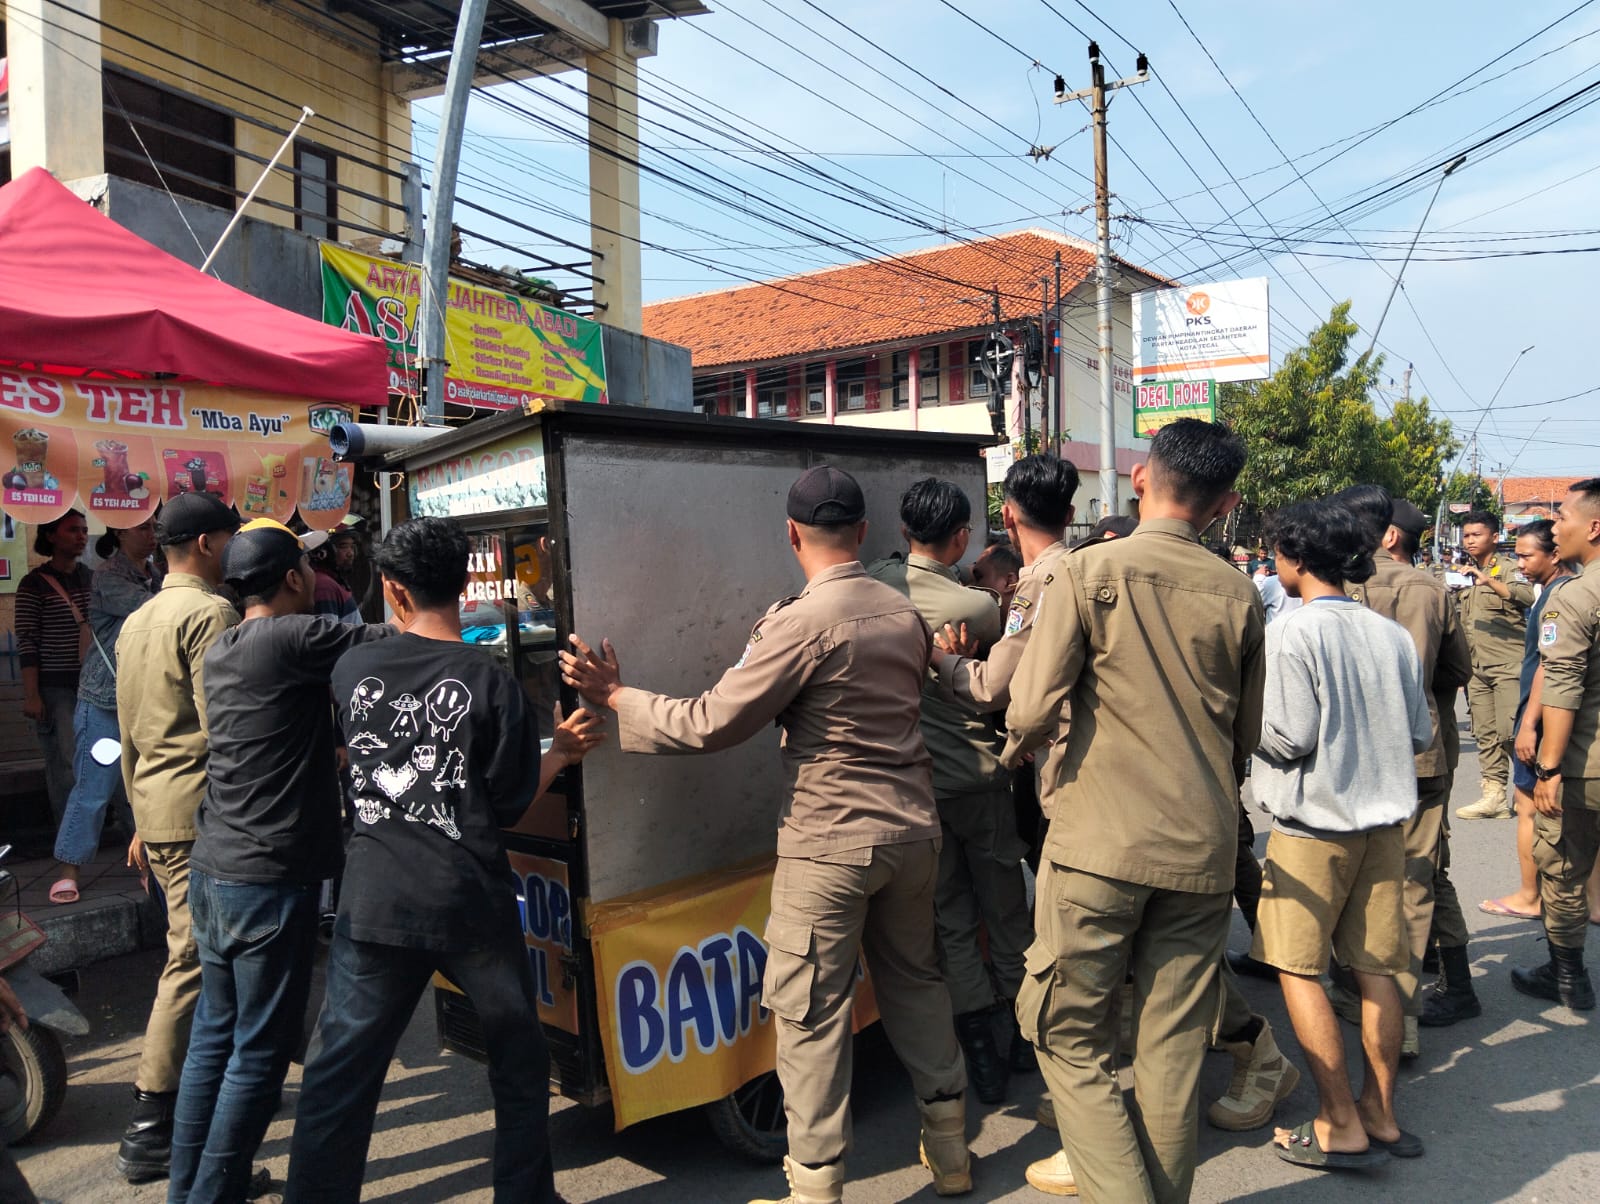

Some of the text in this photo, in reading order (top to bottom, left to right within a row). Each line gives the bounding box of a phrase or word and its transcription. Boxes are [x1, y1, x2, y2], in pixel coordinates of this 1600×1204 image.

[366, 262, 421, 297] ARTA
[533, 309, 578, 340] ABADI
[1185, 315, 1212, 327] PKS
[1142, 324, 1258, 343] DEWAN PIMPINAN TINGKAT DAERAH
[1151, 332, 1247, 348] PARTAI KEADILAN SEJAHTERA
[1179, 341, 1220, 352] KOTA TEGAL
[0, 371, 63, 416] ES
[74, 382, 186, 428] TEH
[1135, 380, 1209, 410] IDEAL HOME
[11, 491, 56, 504] ES TEH LECI
[93, 497, 140, 509] ES TEH APEL
[612, 924, 773, 1076] BATA
